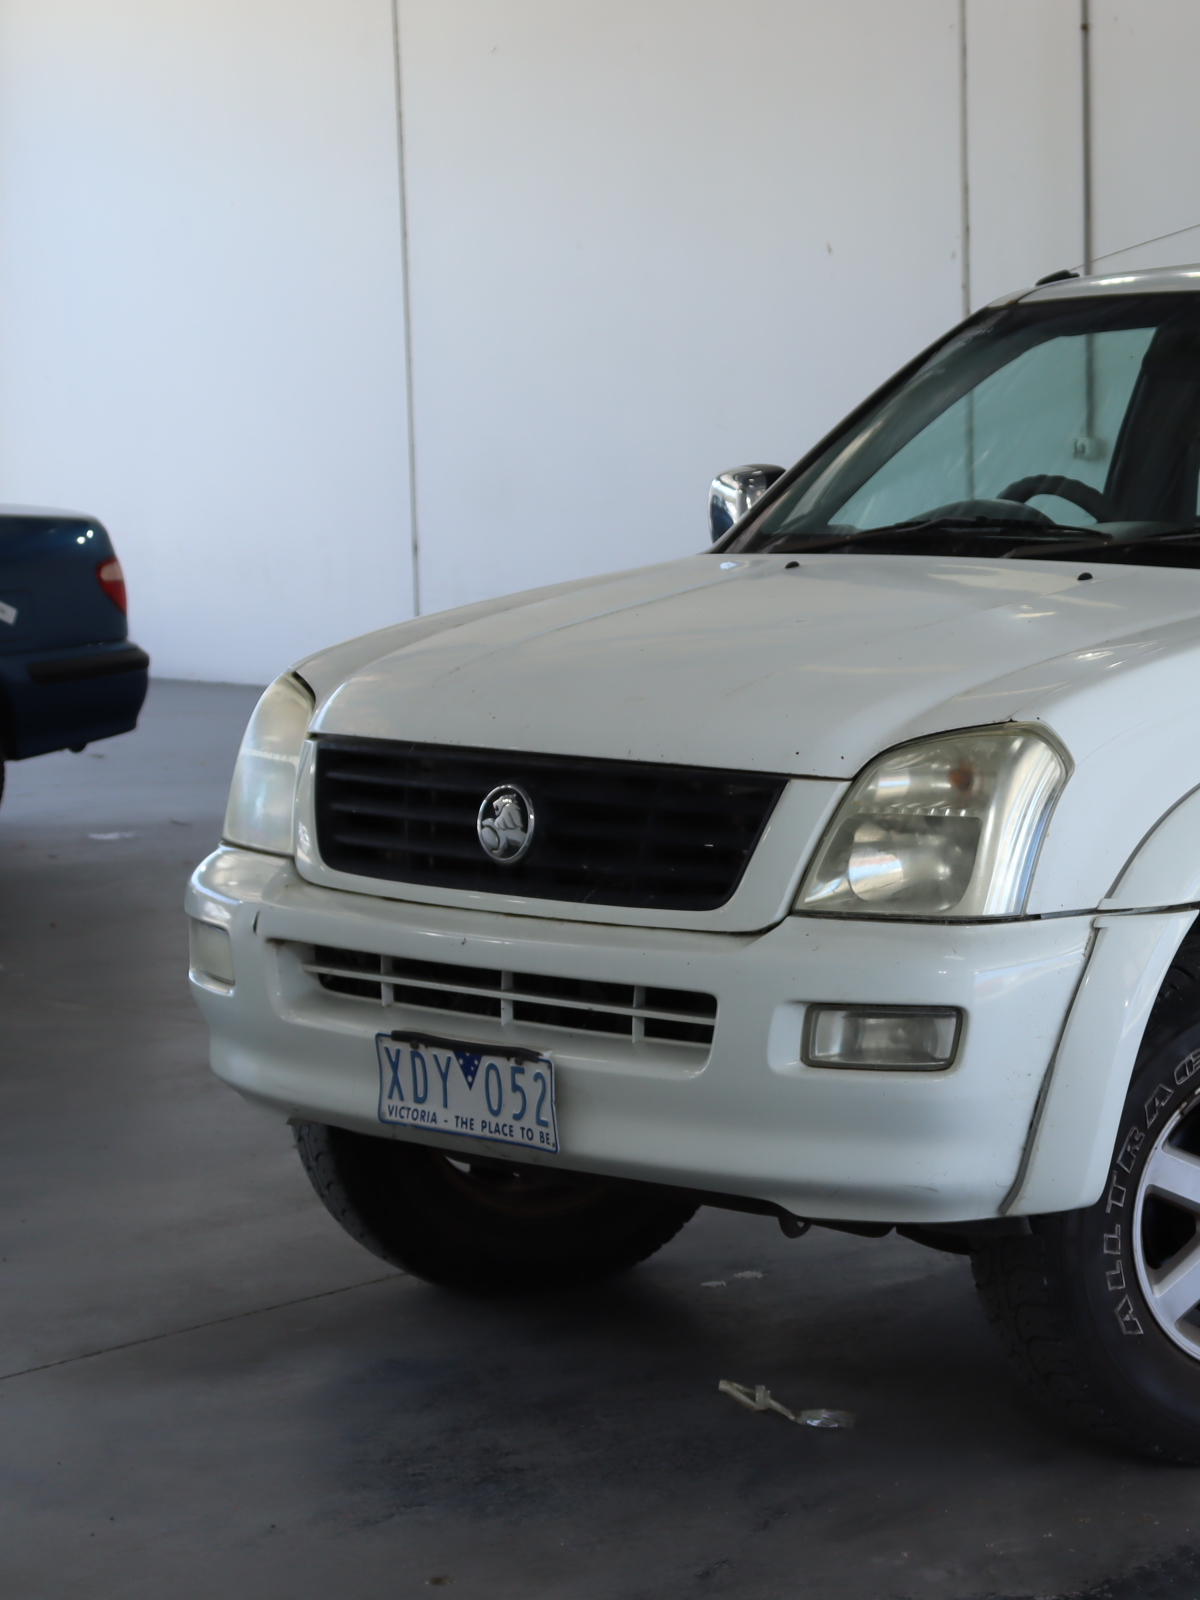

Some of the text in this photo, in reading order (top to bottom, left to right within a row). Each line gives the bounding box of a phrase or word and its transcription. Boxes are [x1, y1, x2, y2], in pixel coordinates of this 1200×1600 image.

[383, 1046, 550, 1128] XDY 052
[387, 1104, 437, 1124] VICTORIA
[454, 1115, 475, 1131] THE
[480, 1120, 514, 1138] PLACE
[519, 1126, 534, 1141] TO
[538, 1130, 551, 1145] BE
